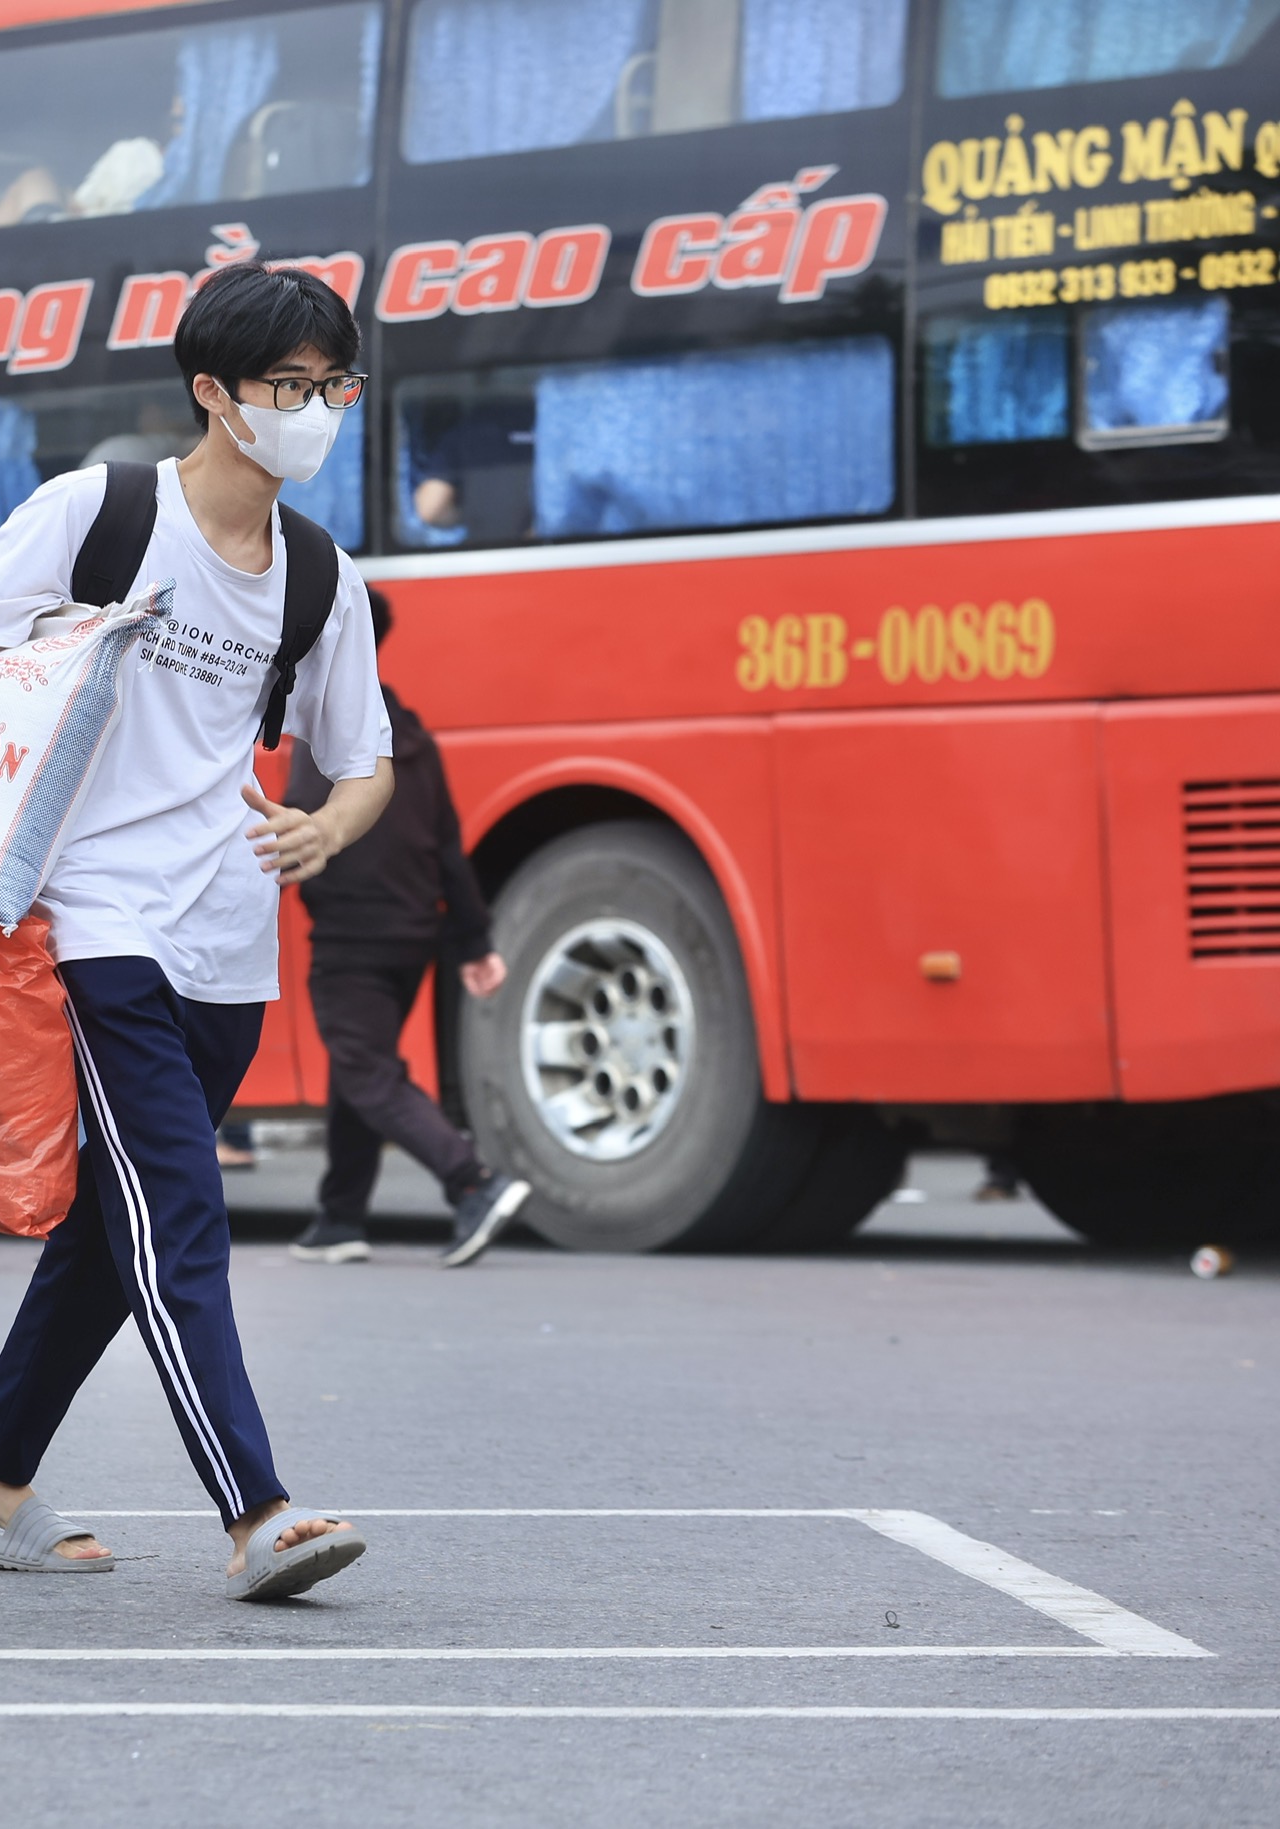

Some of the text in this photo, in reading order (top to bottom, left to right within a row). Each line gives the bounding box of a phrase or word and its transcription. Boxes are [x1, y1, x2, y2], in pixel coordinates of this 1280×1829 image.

[922, 98, 1280, 215] QUẢNG MẬN Q
[375, 223, 610, 323] cao
[631, 164, 888, 303] cấp
[1058, 263, 1116, 303] 313
[178, 642, 199, 660] TURN
[735, 597, 1056, 693] 36B-00869
